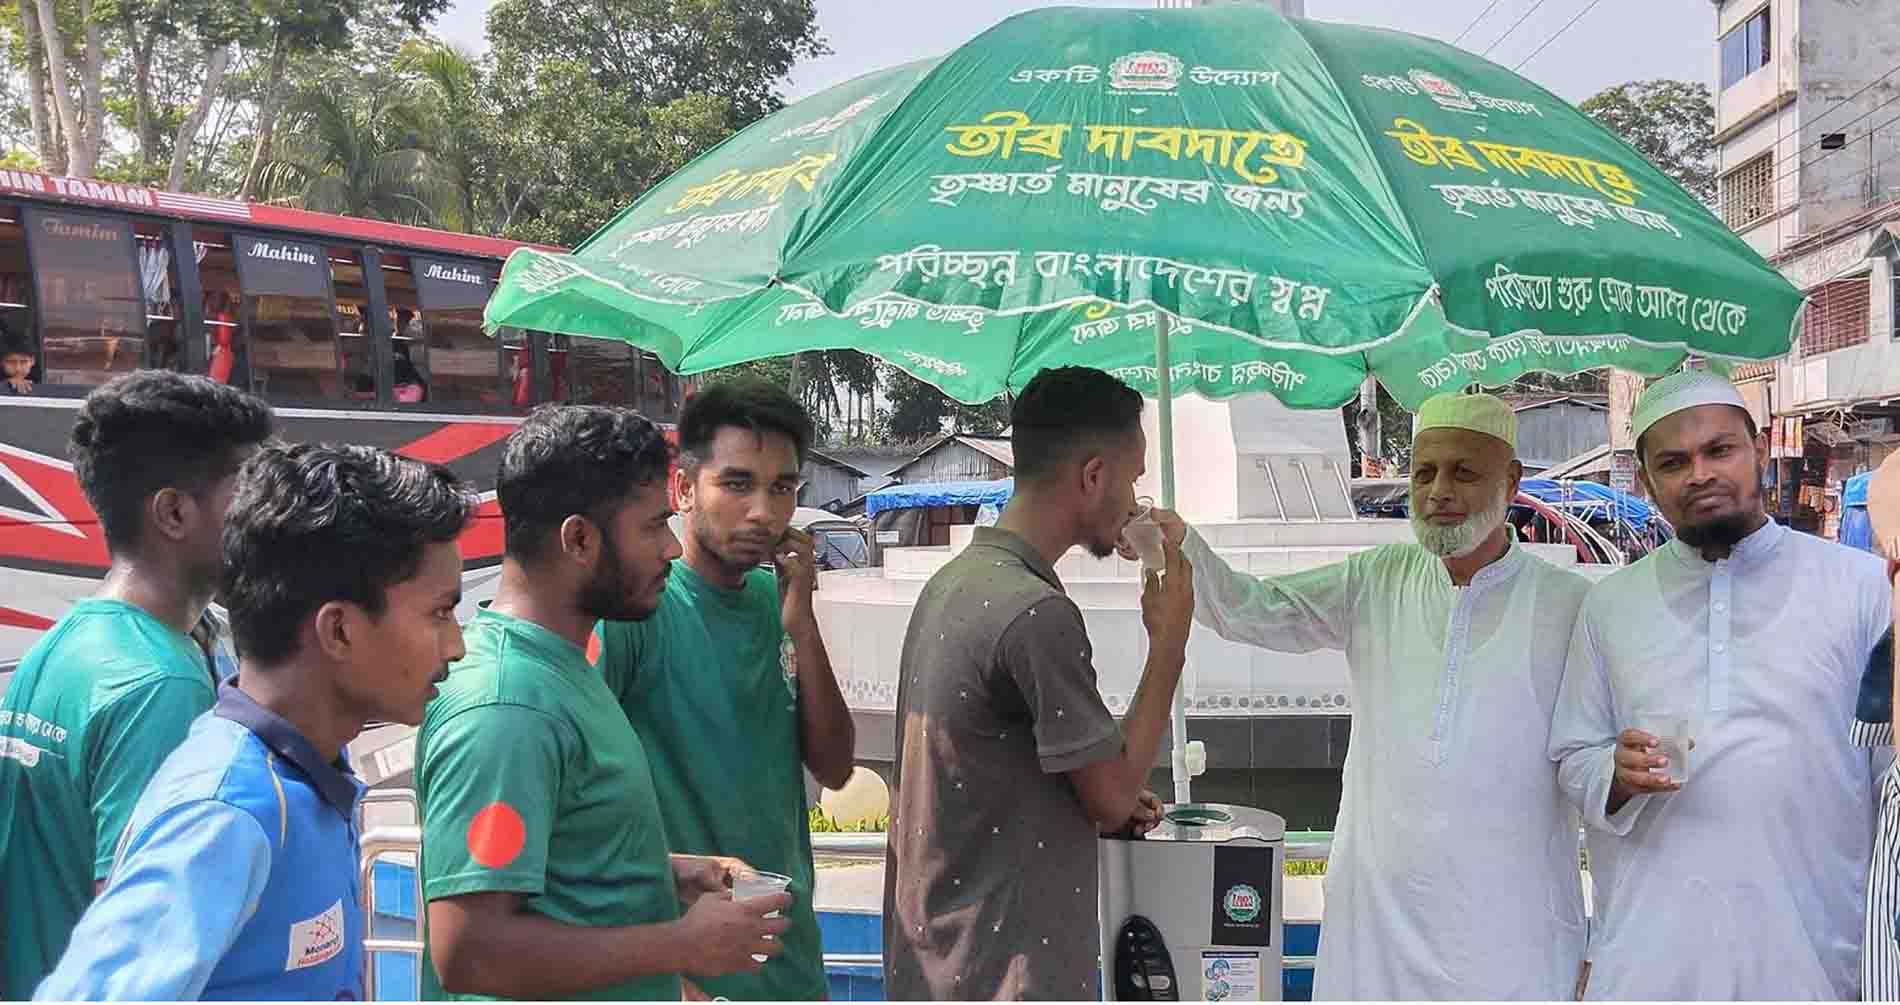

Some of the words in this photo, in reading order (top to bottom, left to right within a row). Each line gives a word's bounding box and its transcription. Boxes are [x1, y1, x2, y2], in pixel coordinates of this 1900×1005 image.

[1008, 64, 1101, 85] একটি
[1188, 66, 1281, 88] উদ্যোগ
[943, 110, 1072, 160] তীব্র
[50, 175, 153, 207] TAMIM
[928, 164, 1063, 207] তৃষ্ণার্ত
[1066, 173, 1214, 215] মানুষের
[1222, 182, 1312, 219] জন্য
[247, 242, 317, 265] Mahim
[423, 264, 484, 285] Mahim
[876, 244, 1021, 289] পরিচ্ছন্ন
[1034, 250, 1256, 307] বাংলাদেশের
[1269, 274, 1332, 322] স্বপ্ন
[1691, 296, 1748, 335] থেকে
